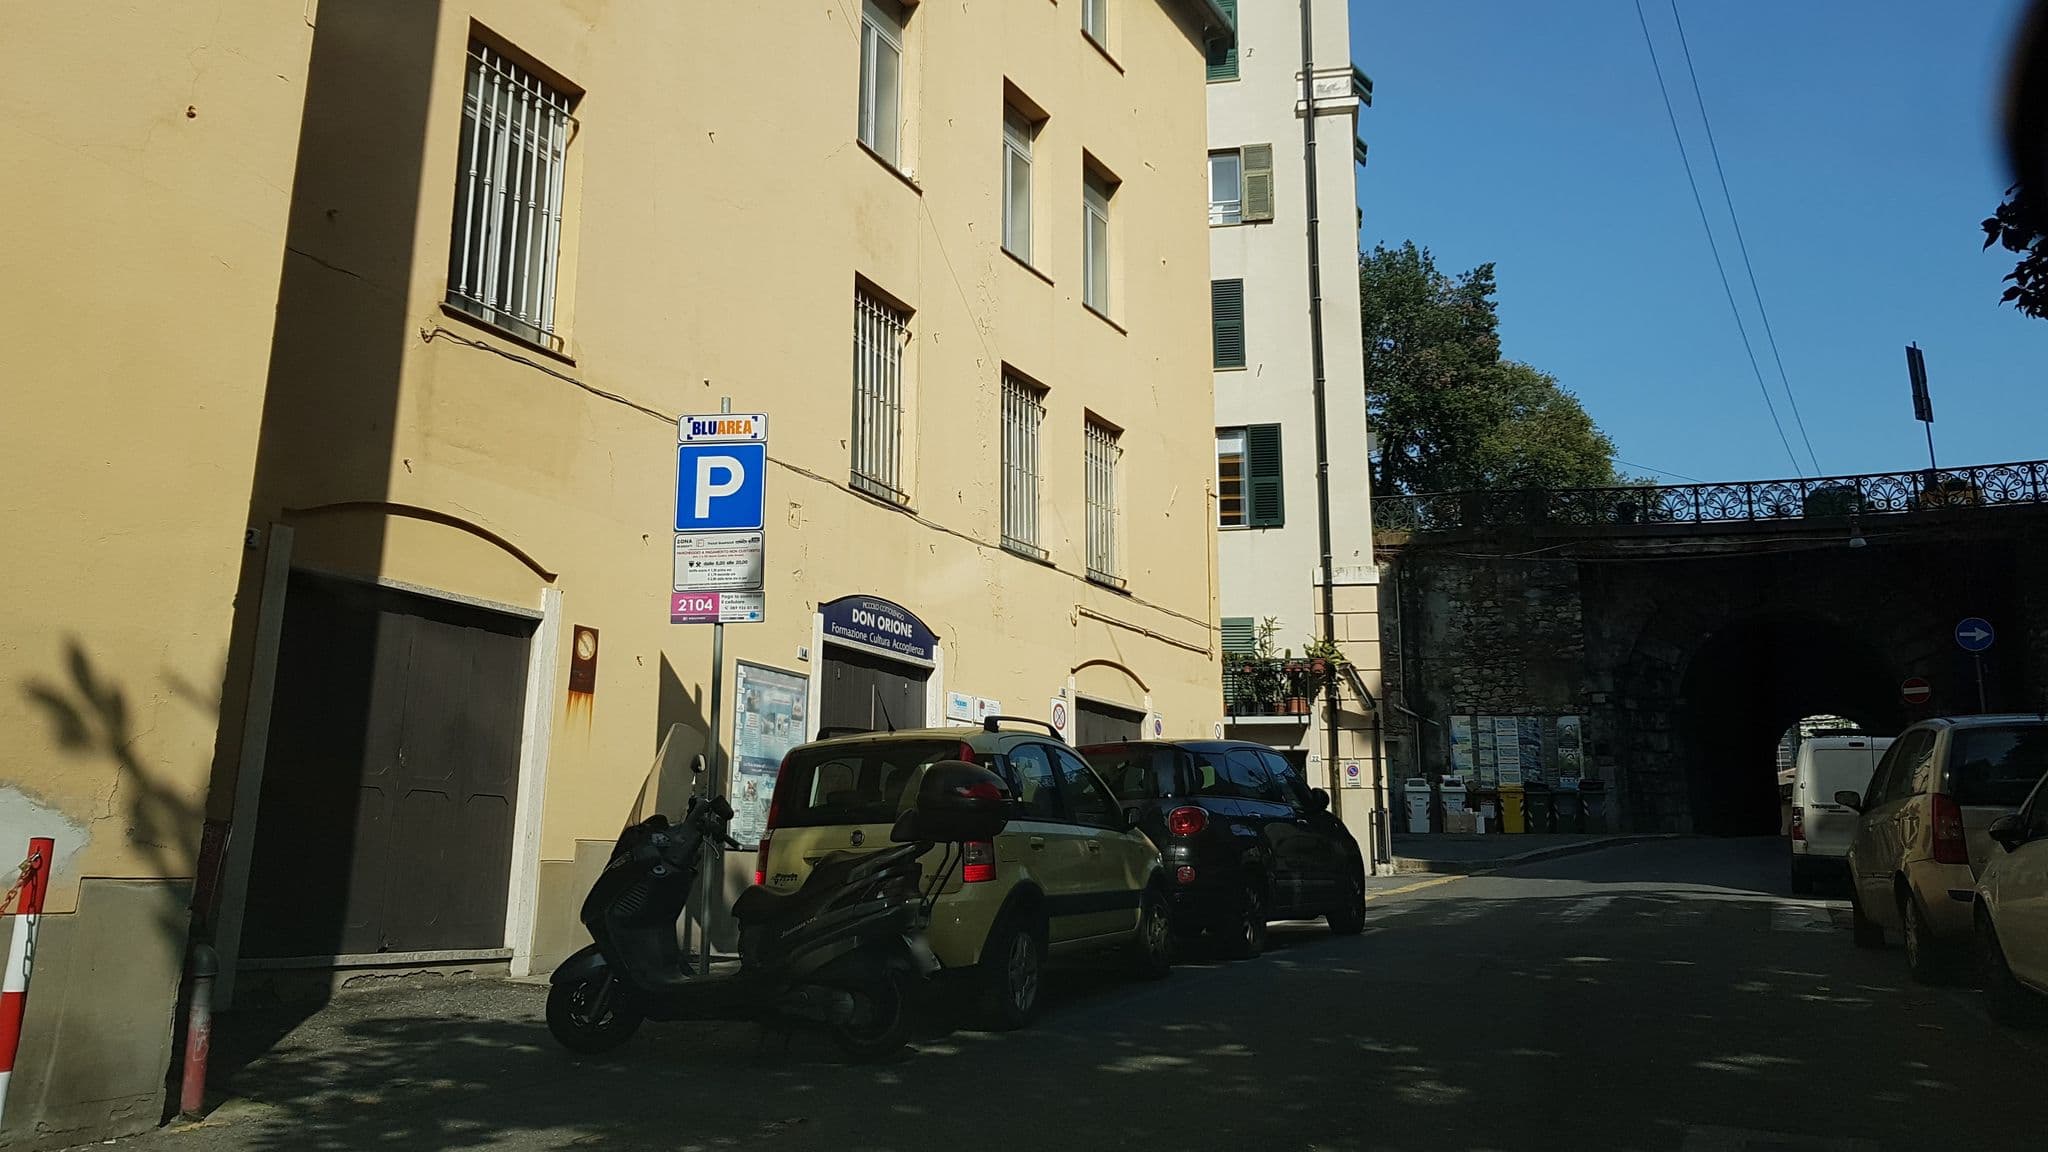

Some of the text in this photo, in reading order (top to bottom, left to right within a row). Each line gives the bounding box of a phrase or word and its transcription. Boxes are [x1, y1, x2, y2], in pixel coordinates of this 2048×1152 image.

[692, 420, 752, 435] BLUAREA
[695, 456, 744, 518] P
[678, 599, 713, 611] 2104
[852, 608, 913, 638] DON ORIONE
[831, 622, 924, 655] Formazione Cultura Accoglienza
